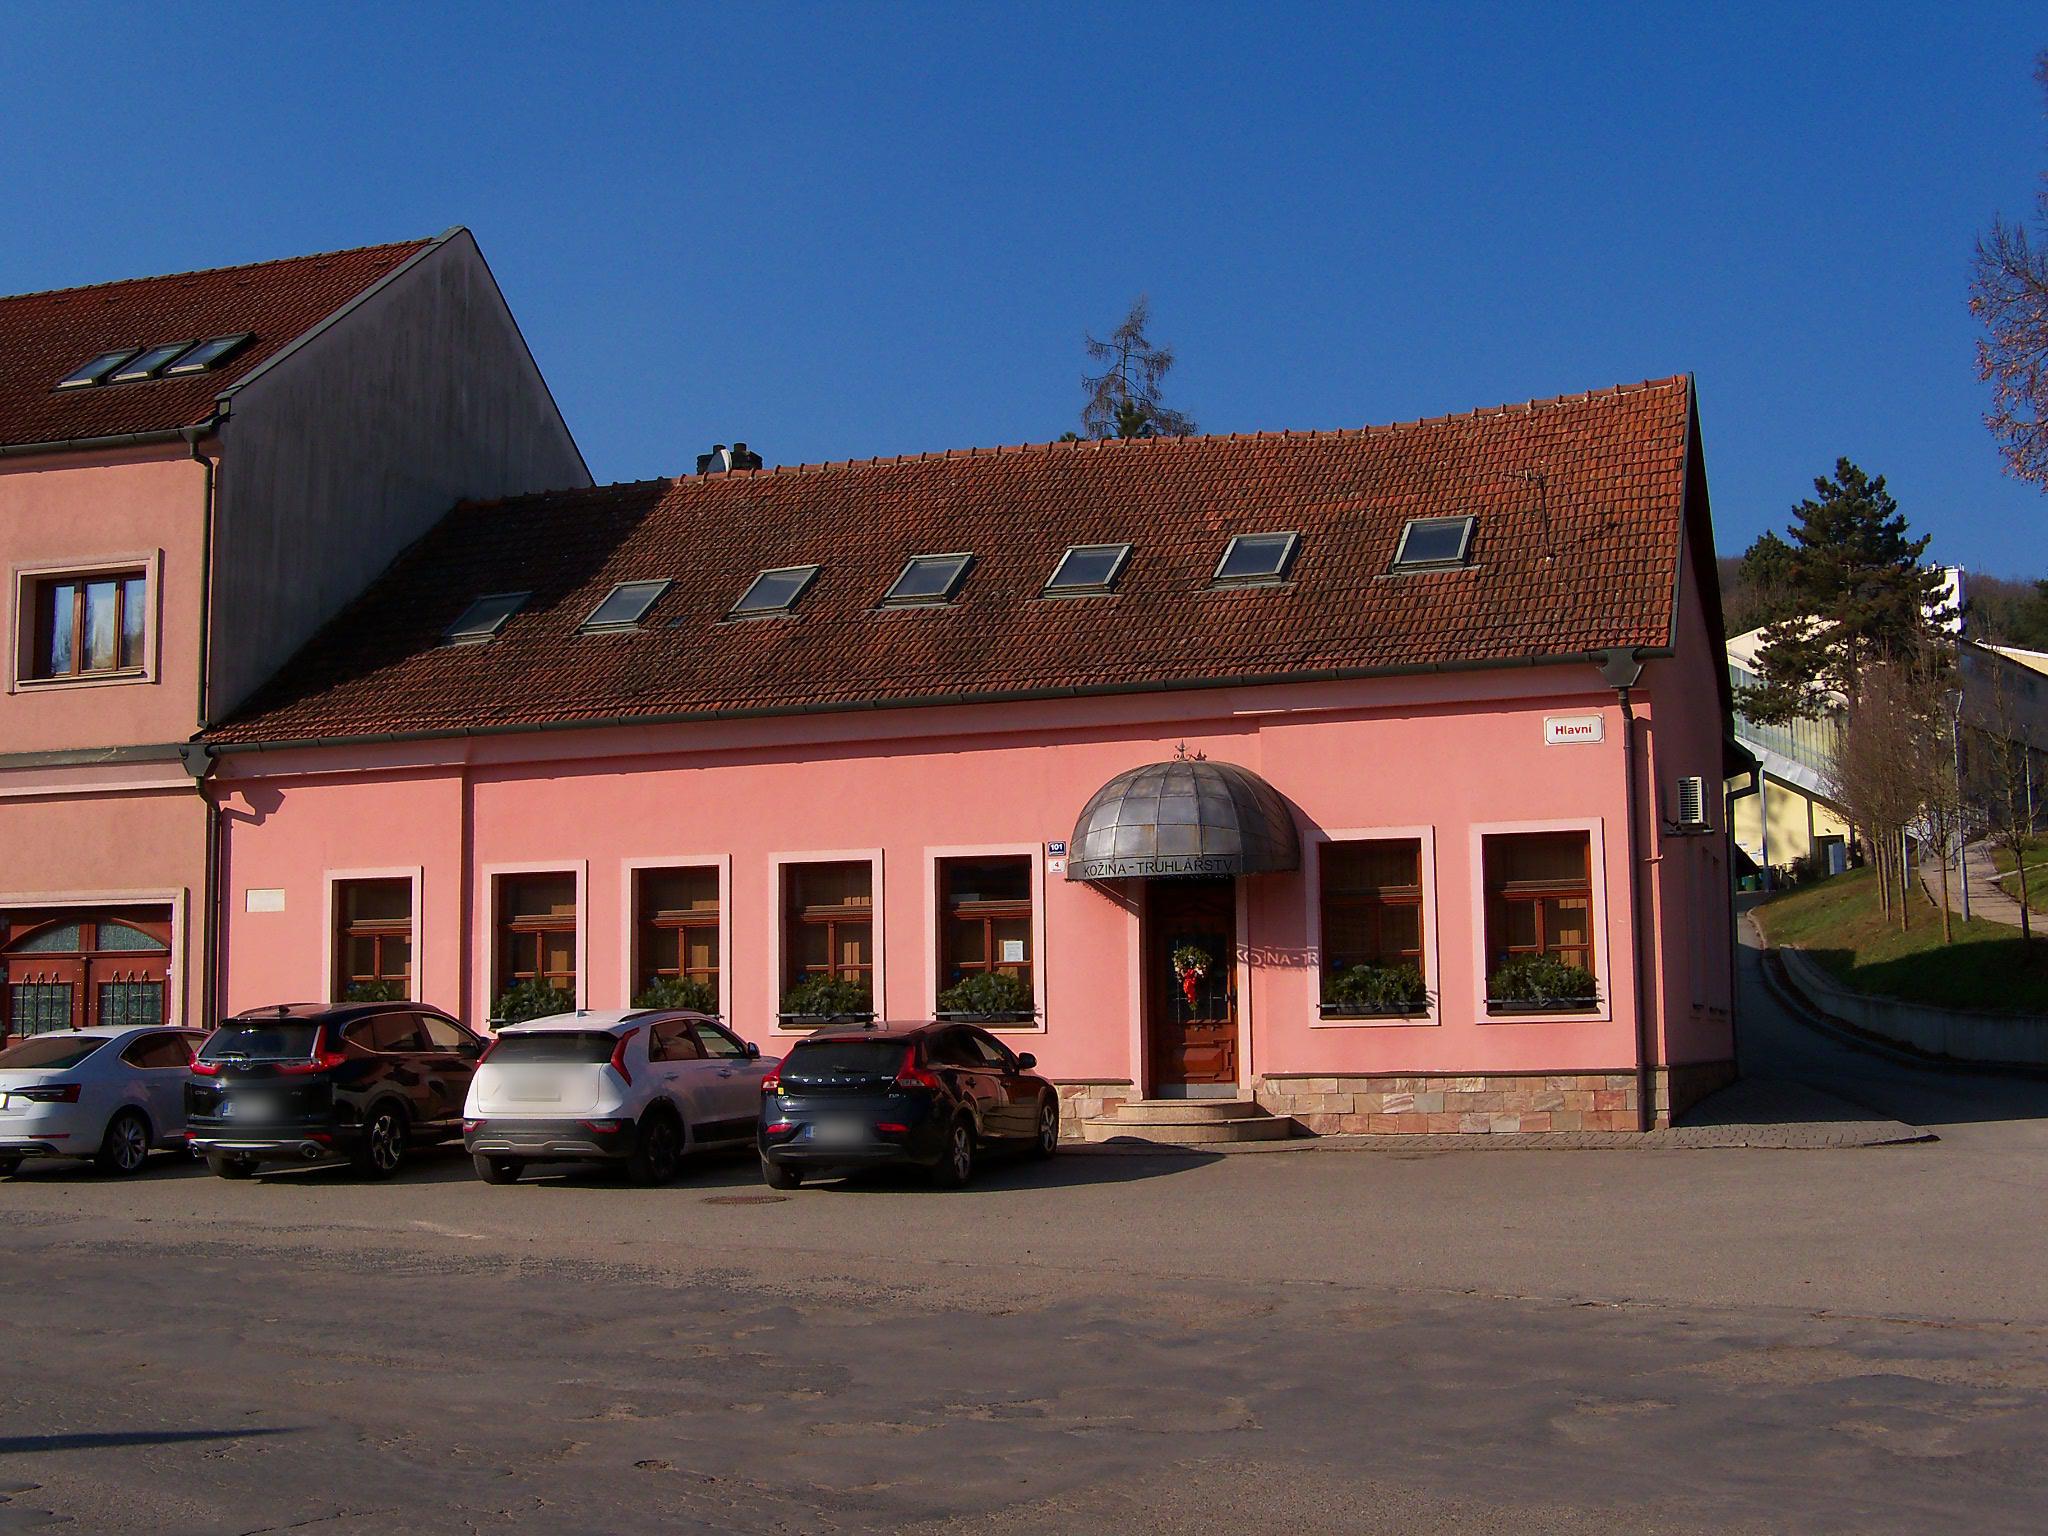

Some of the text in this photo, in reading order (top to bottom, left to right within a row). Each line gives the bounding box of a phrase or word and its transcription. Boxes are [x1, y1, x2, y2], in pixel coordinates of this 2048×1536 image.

[1555, 723, 1592, 735] Hlavní
[1050, 843, 1063, 851] 101
[1084, 862, 1127, 877] KOŽINA
